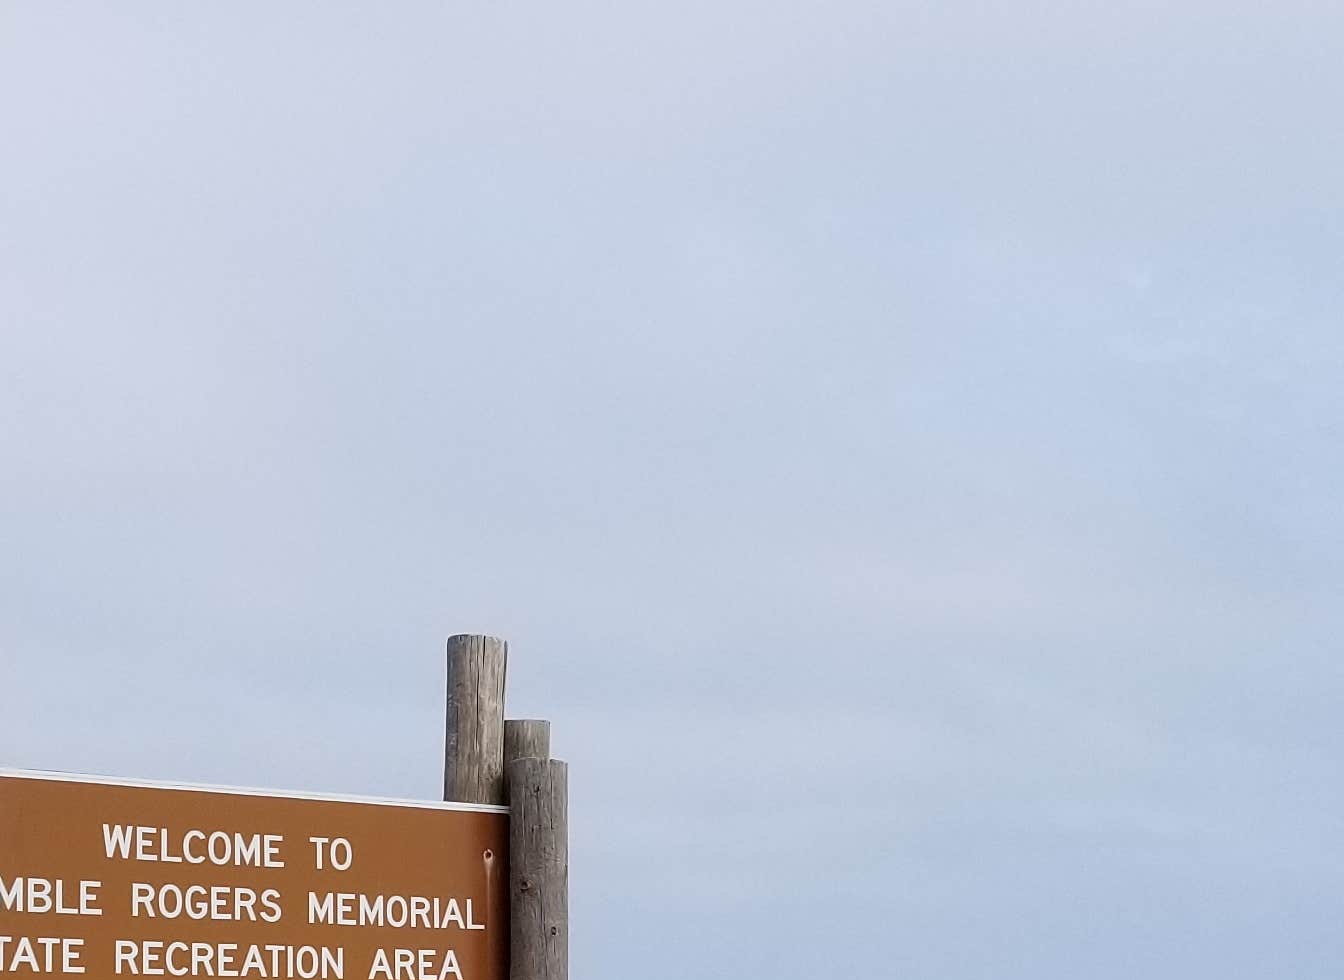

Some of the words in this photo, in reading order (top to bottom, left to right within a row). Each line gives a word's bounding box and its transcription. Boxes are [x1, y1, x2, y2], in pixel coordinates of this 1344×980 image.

[102, 823, 285, 868] WELCOME
[309, 836, 353, 871] TO
[132, 882, 282, 923] ROGERS
[308, 891, 485, 930] MEMORIAL
[115, 939, 344, 980] RECREATION
[368, 948, 464, 980] AREA
